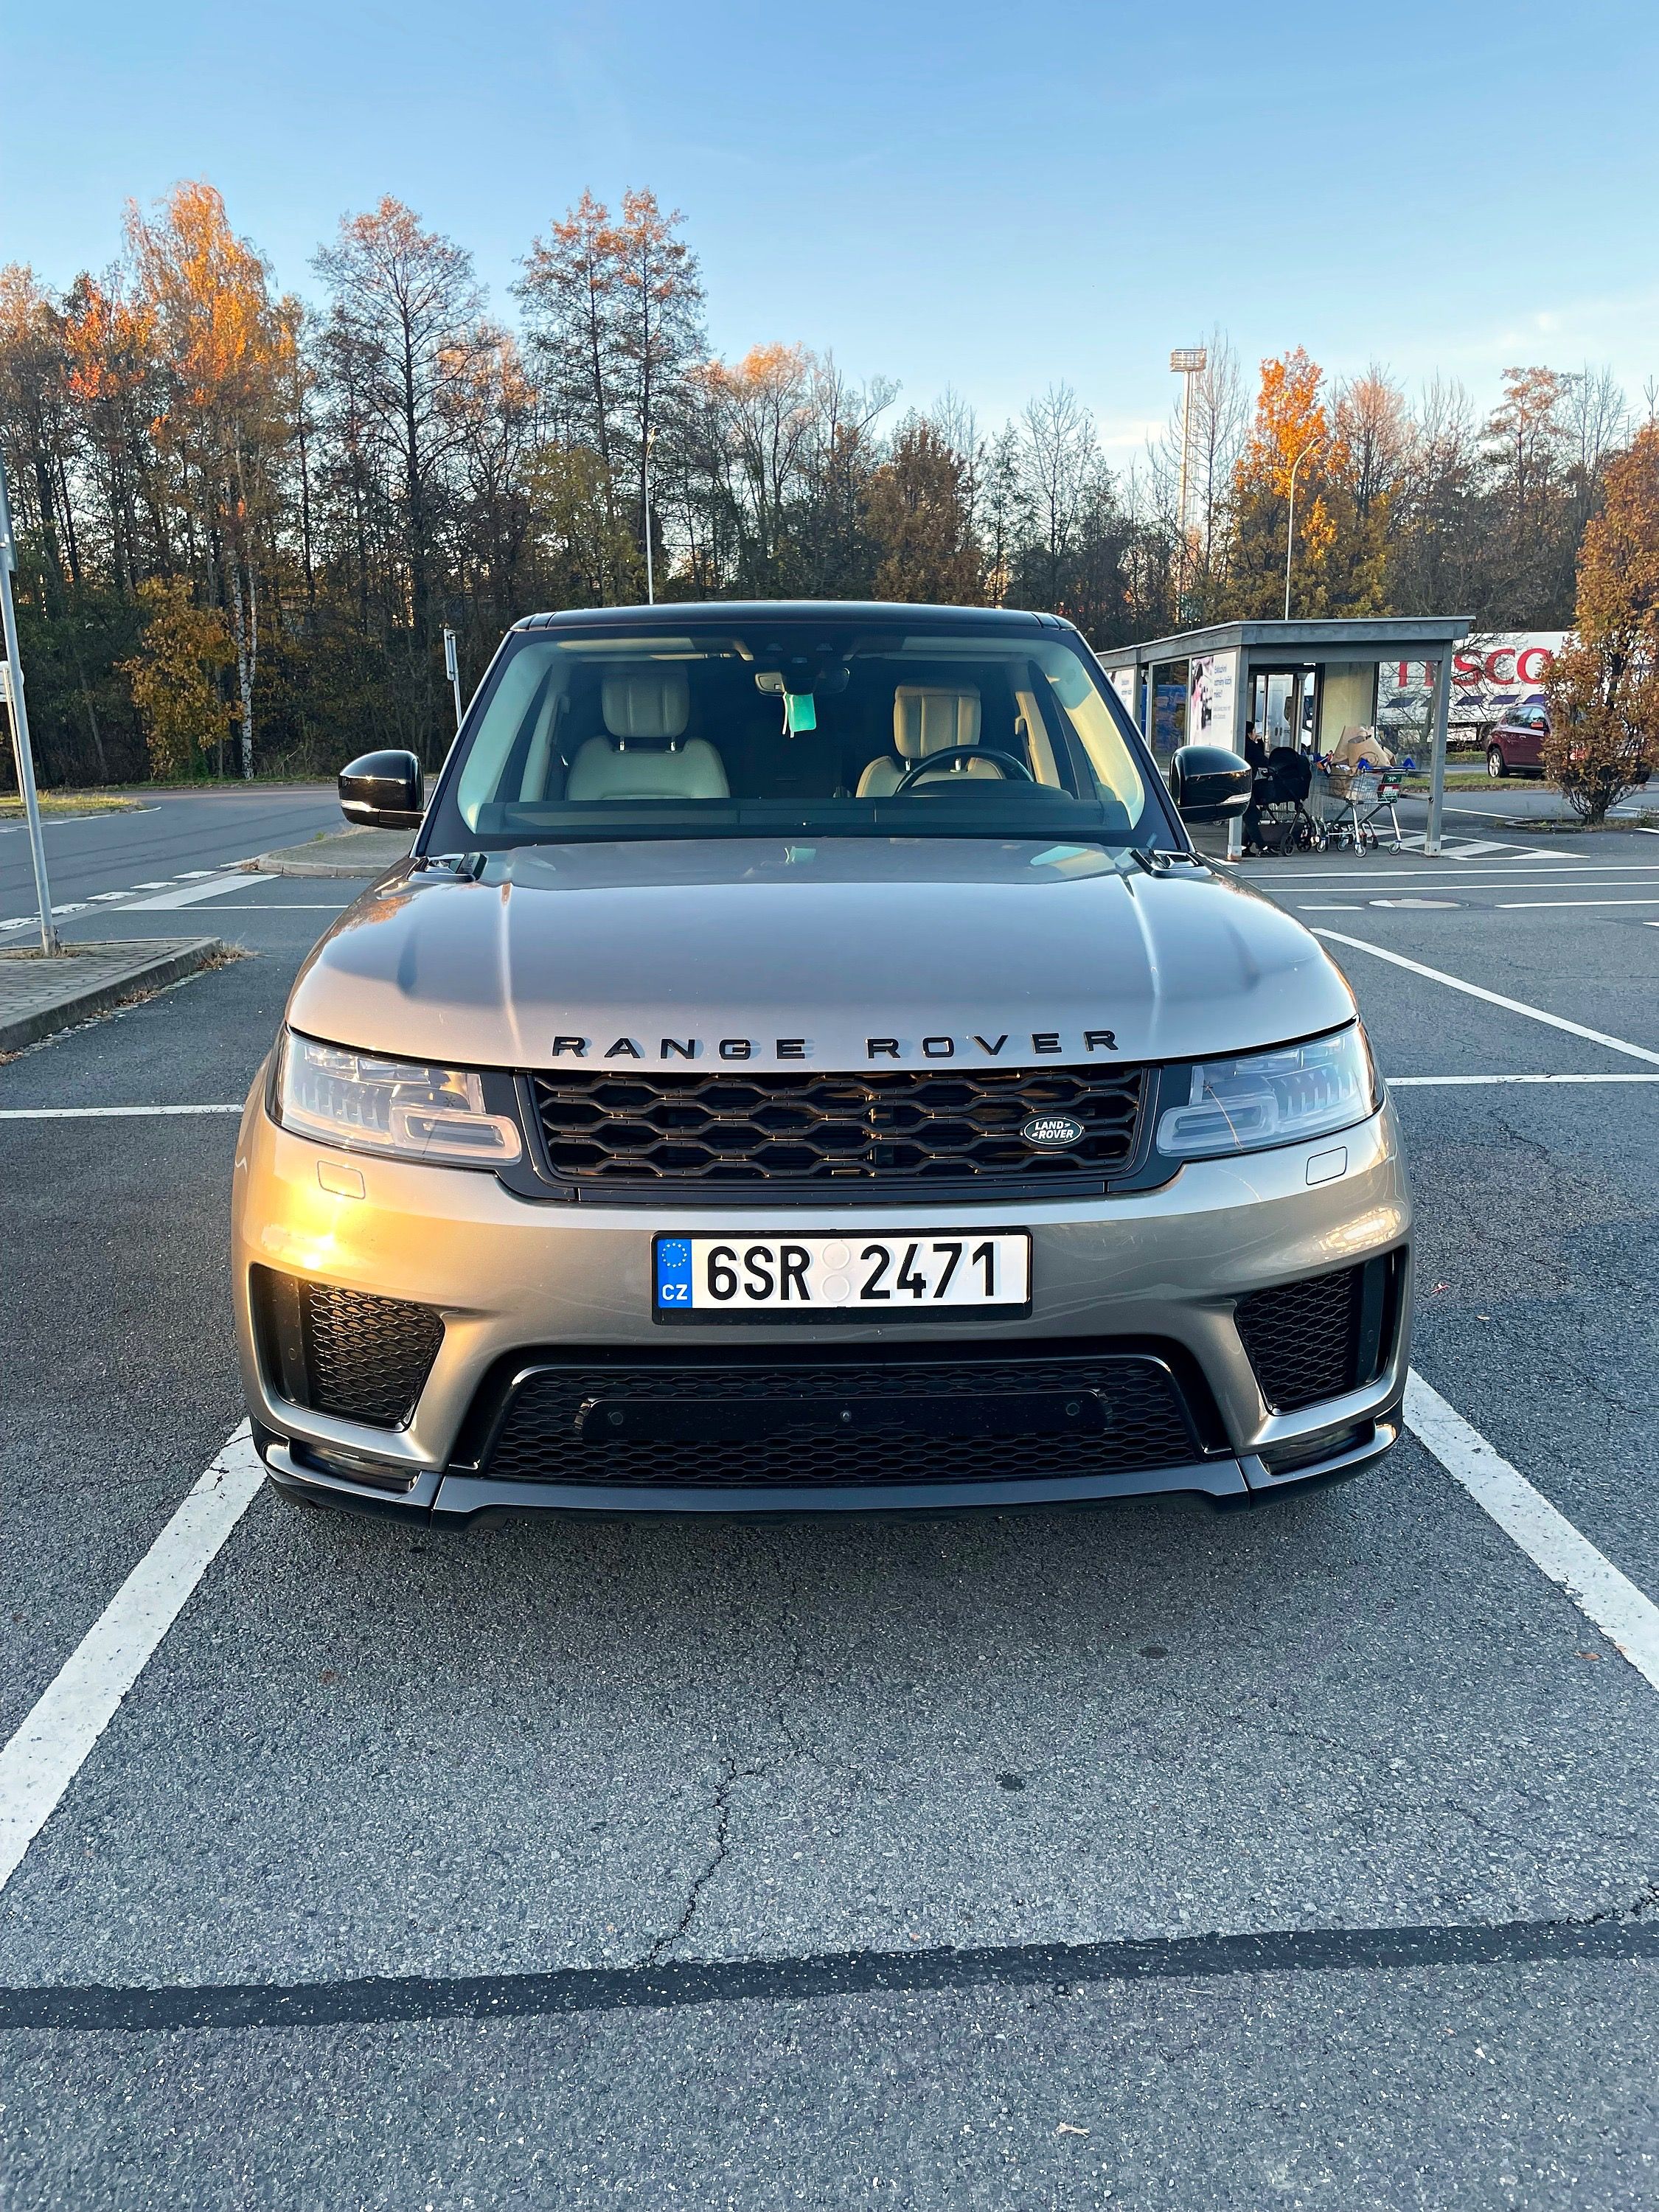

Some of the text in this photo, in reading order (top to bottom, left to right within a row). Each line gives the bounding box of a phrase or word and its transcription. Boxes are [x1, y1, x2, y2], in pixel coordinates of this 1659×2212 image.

[552, 1029, 1119, 1060] RANGE ROVER
[1034, 1121, 1064, 1131] LAND
[1037, 1129, 1074, 1140] ROVER
[706, 1241, 995, 1301] 6SR 2471
[661, 1284, 689, 1301] CZ
